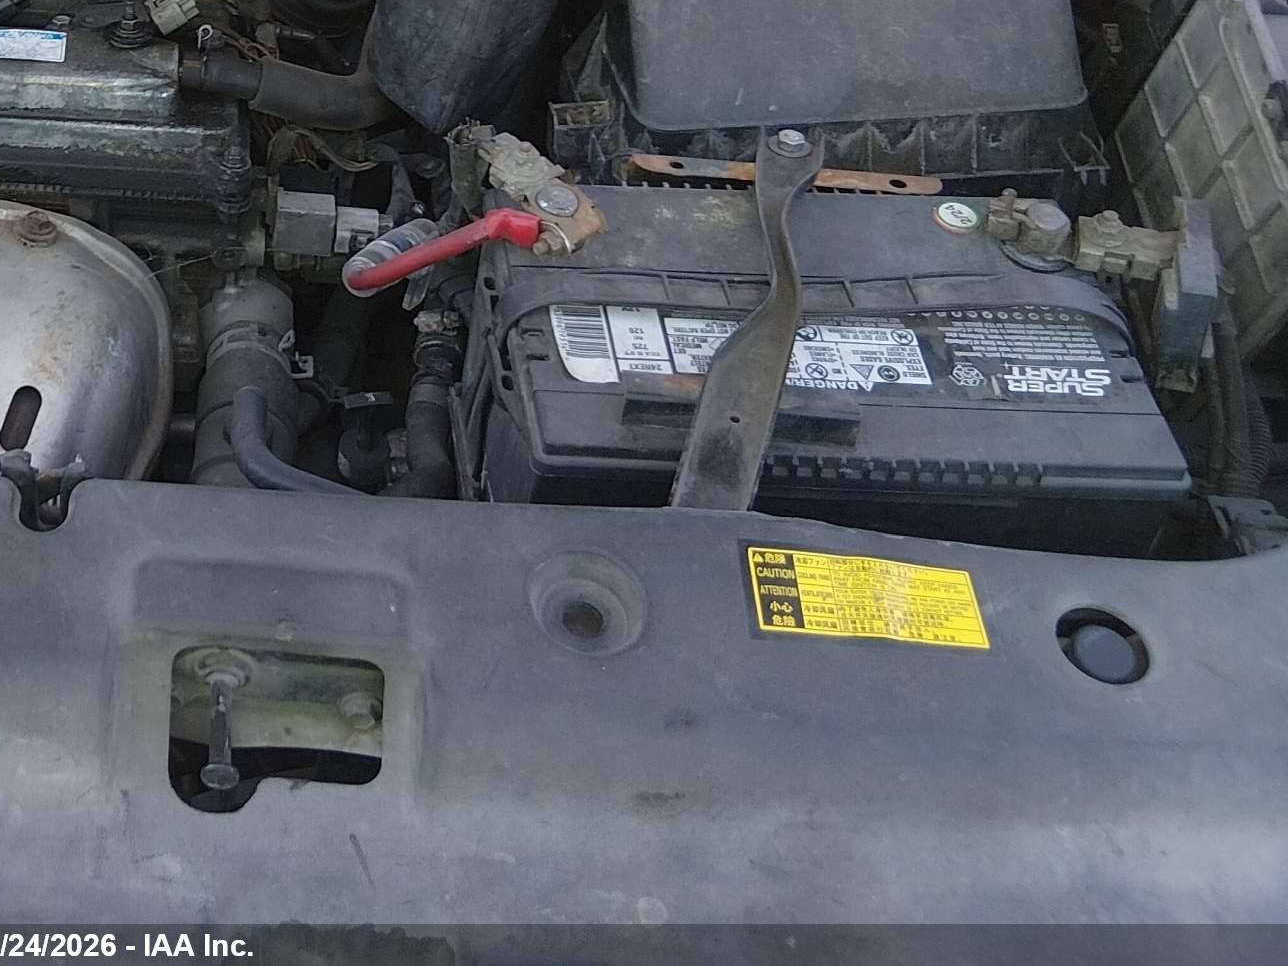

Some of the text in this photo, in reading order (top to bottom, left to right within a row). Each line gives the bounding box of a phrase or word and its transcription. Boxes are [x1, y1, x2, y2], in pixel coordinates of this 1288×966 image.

[1003, 366, 1111, 385] START
[1007, 379, 1104, 397] SUPER
[756, 567, 796, 579] CAUTION
[760, 584, 798, 597] ATTENTION
[769, 600, 794, 613] 小心
